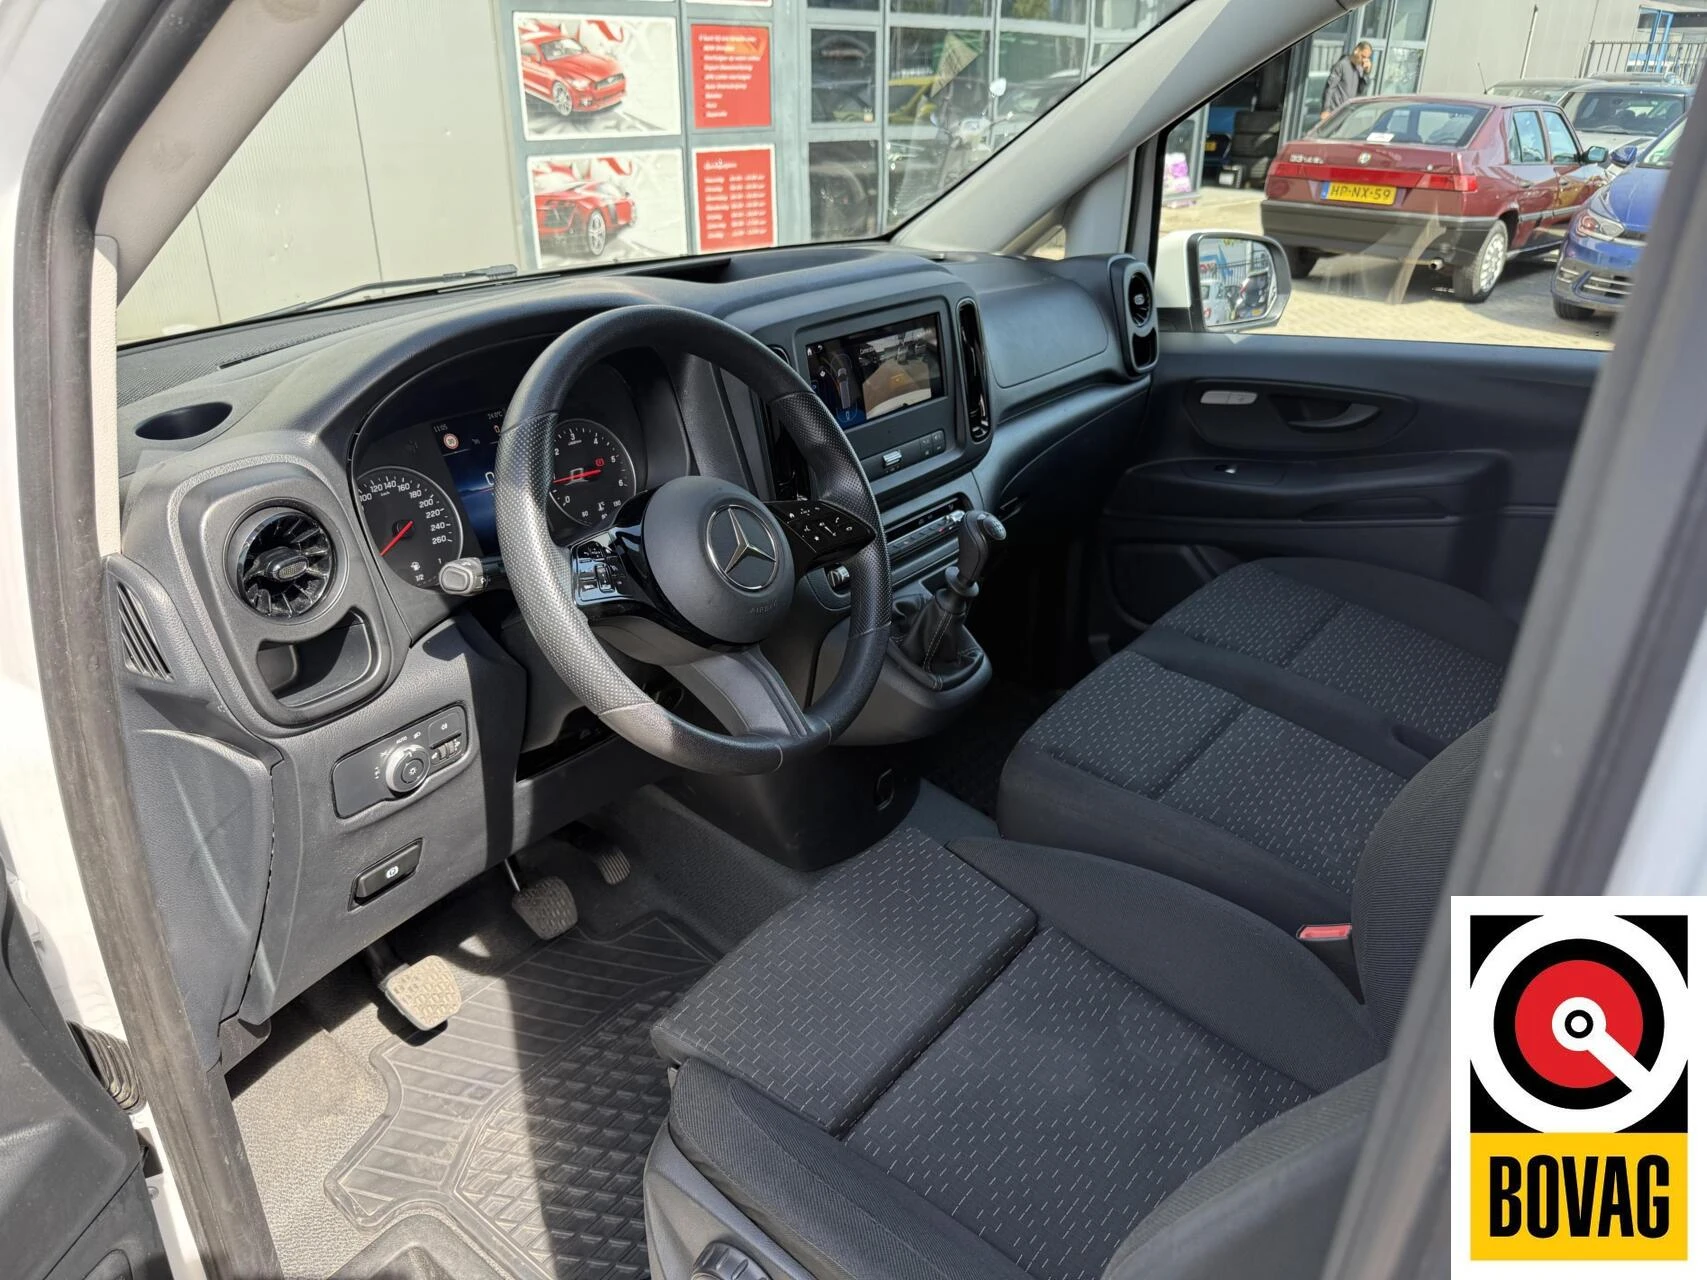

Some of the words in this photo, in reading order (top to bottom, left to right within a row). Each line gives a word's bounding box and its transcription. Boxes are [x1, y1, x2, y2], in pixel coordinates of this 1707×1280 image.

[1330, 184, 1391, 200] HP-NX-59
[593, 437, 599, 445] 4
[370, 484, 383, 493] 120
[384, 480, 397, 489] 140
[397, 484, 411, 493] 160
[409, 489, 422, 499] 180
[419, 499, 434, 509] 200
[425, 509, 441, 519] 220
[430, 522, 446, 532] 240
[432, 535, 447, 545] 260
